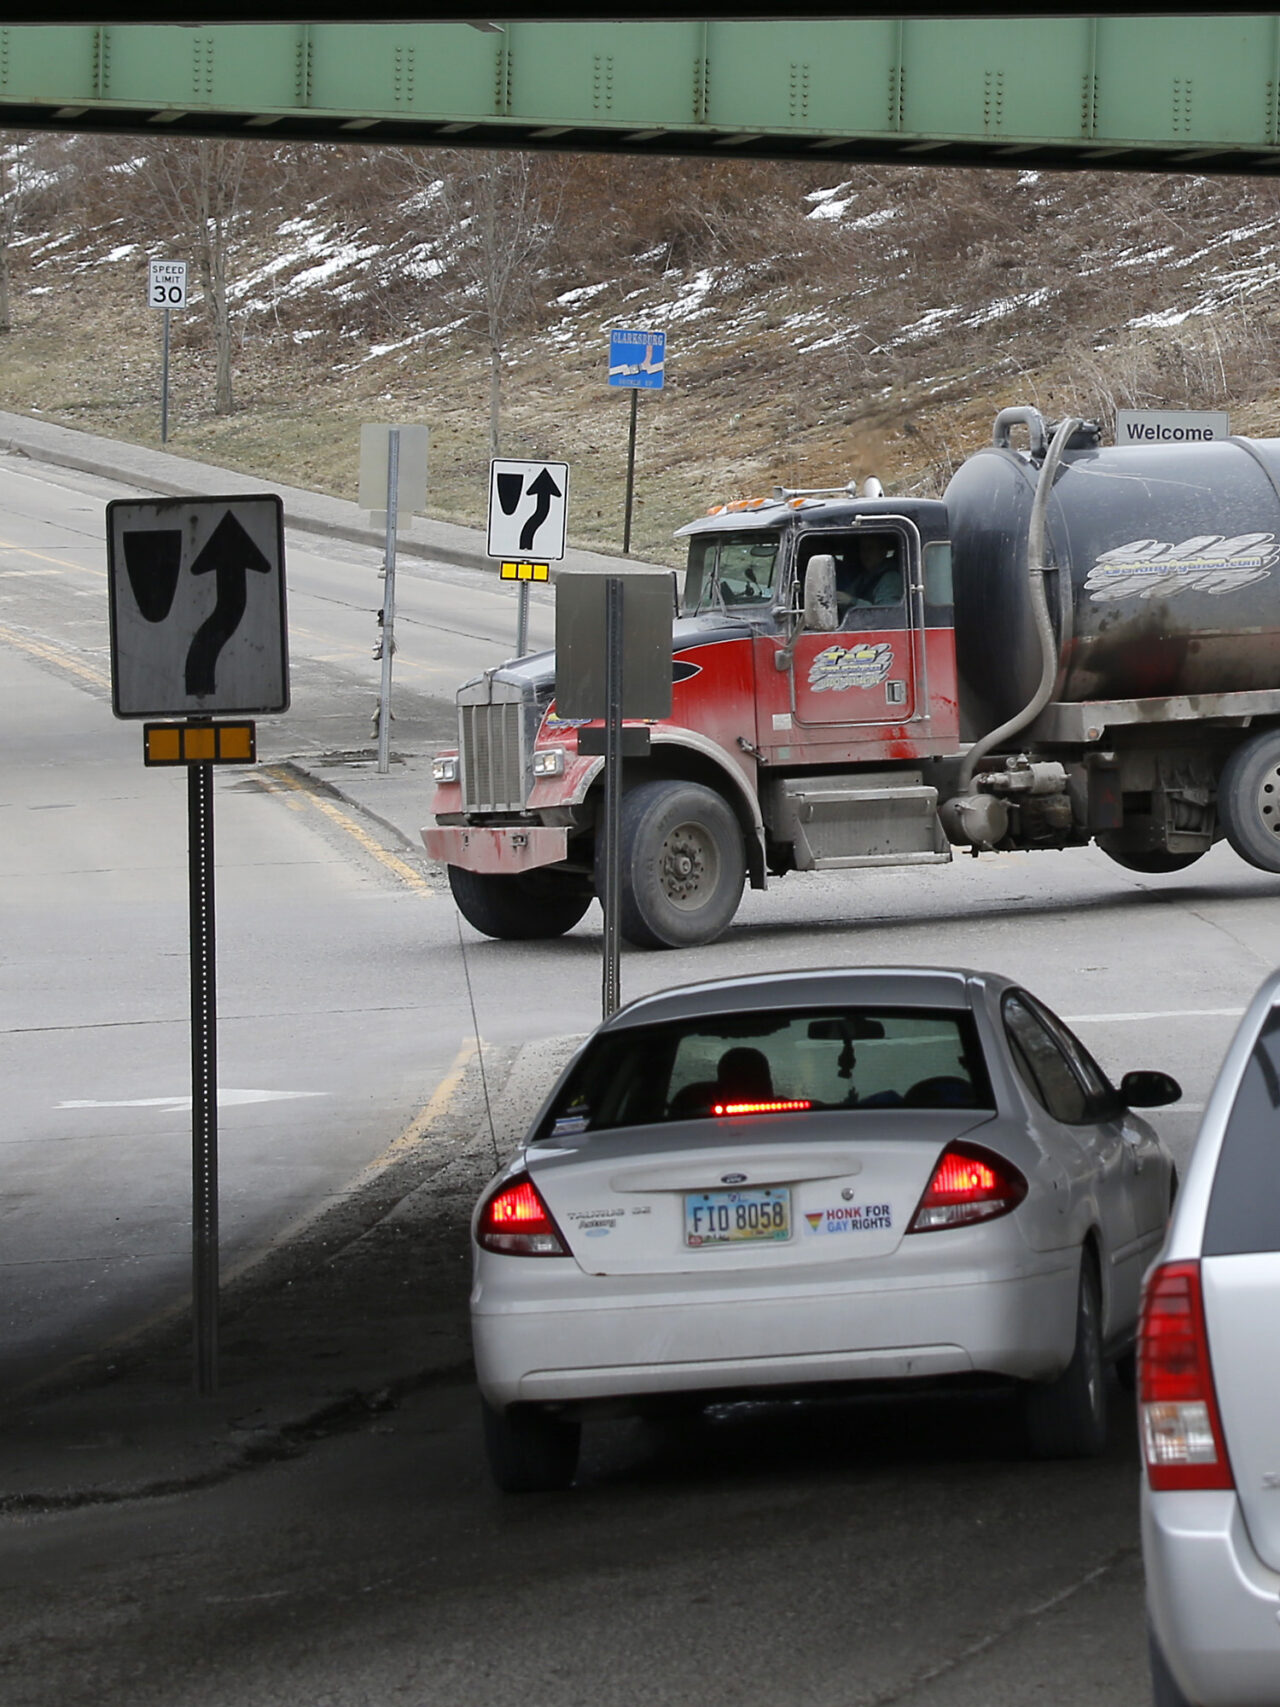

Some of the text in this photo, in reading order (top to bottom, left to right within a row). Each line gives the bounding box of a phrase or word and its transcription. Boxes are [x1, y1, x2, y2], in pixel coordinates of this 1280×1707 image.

[152, 265, 184, 274] SPEED
[153, 285, 182, 303] 30
[613, 332, 664, 346] CLARKSBURG
[1127, 423, 1214, 441] Welcome
[736, 1201, 784, 1231] 8058
[826, 1205, 890, 1220] HONK FOR
[827, 1217, 892, 1233] GAY RIGHTS
